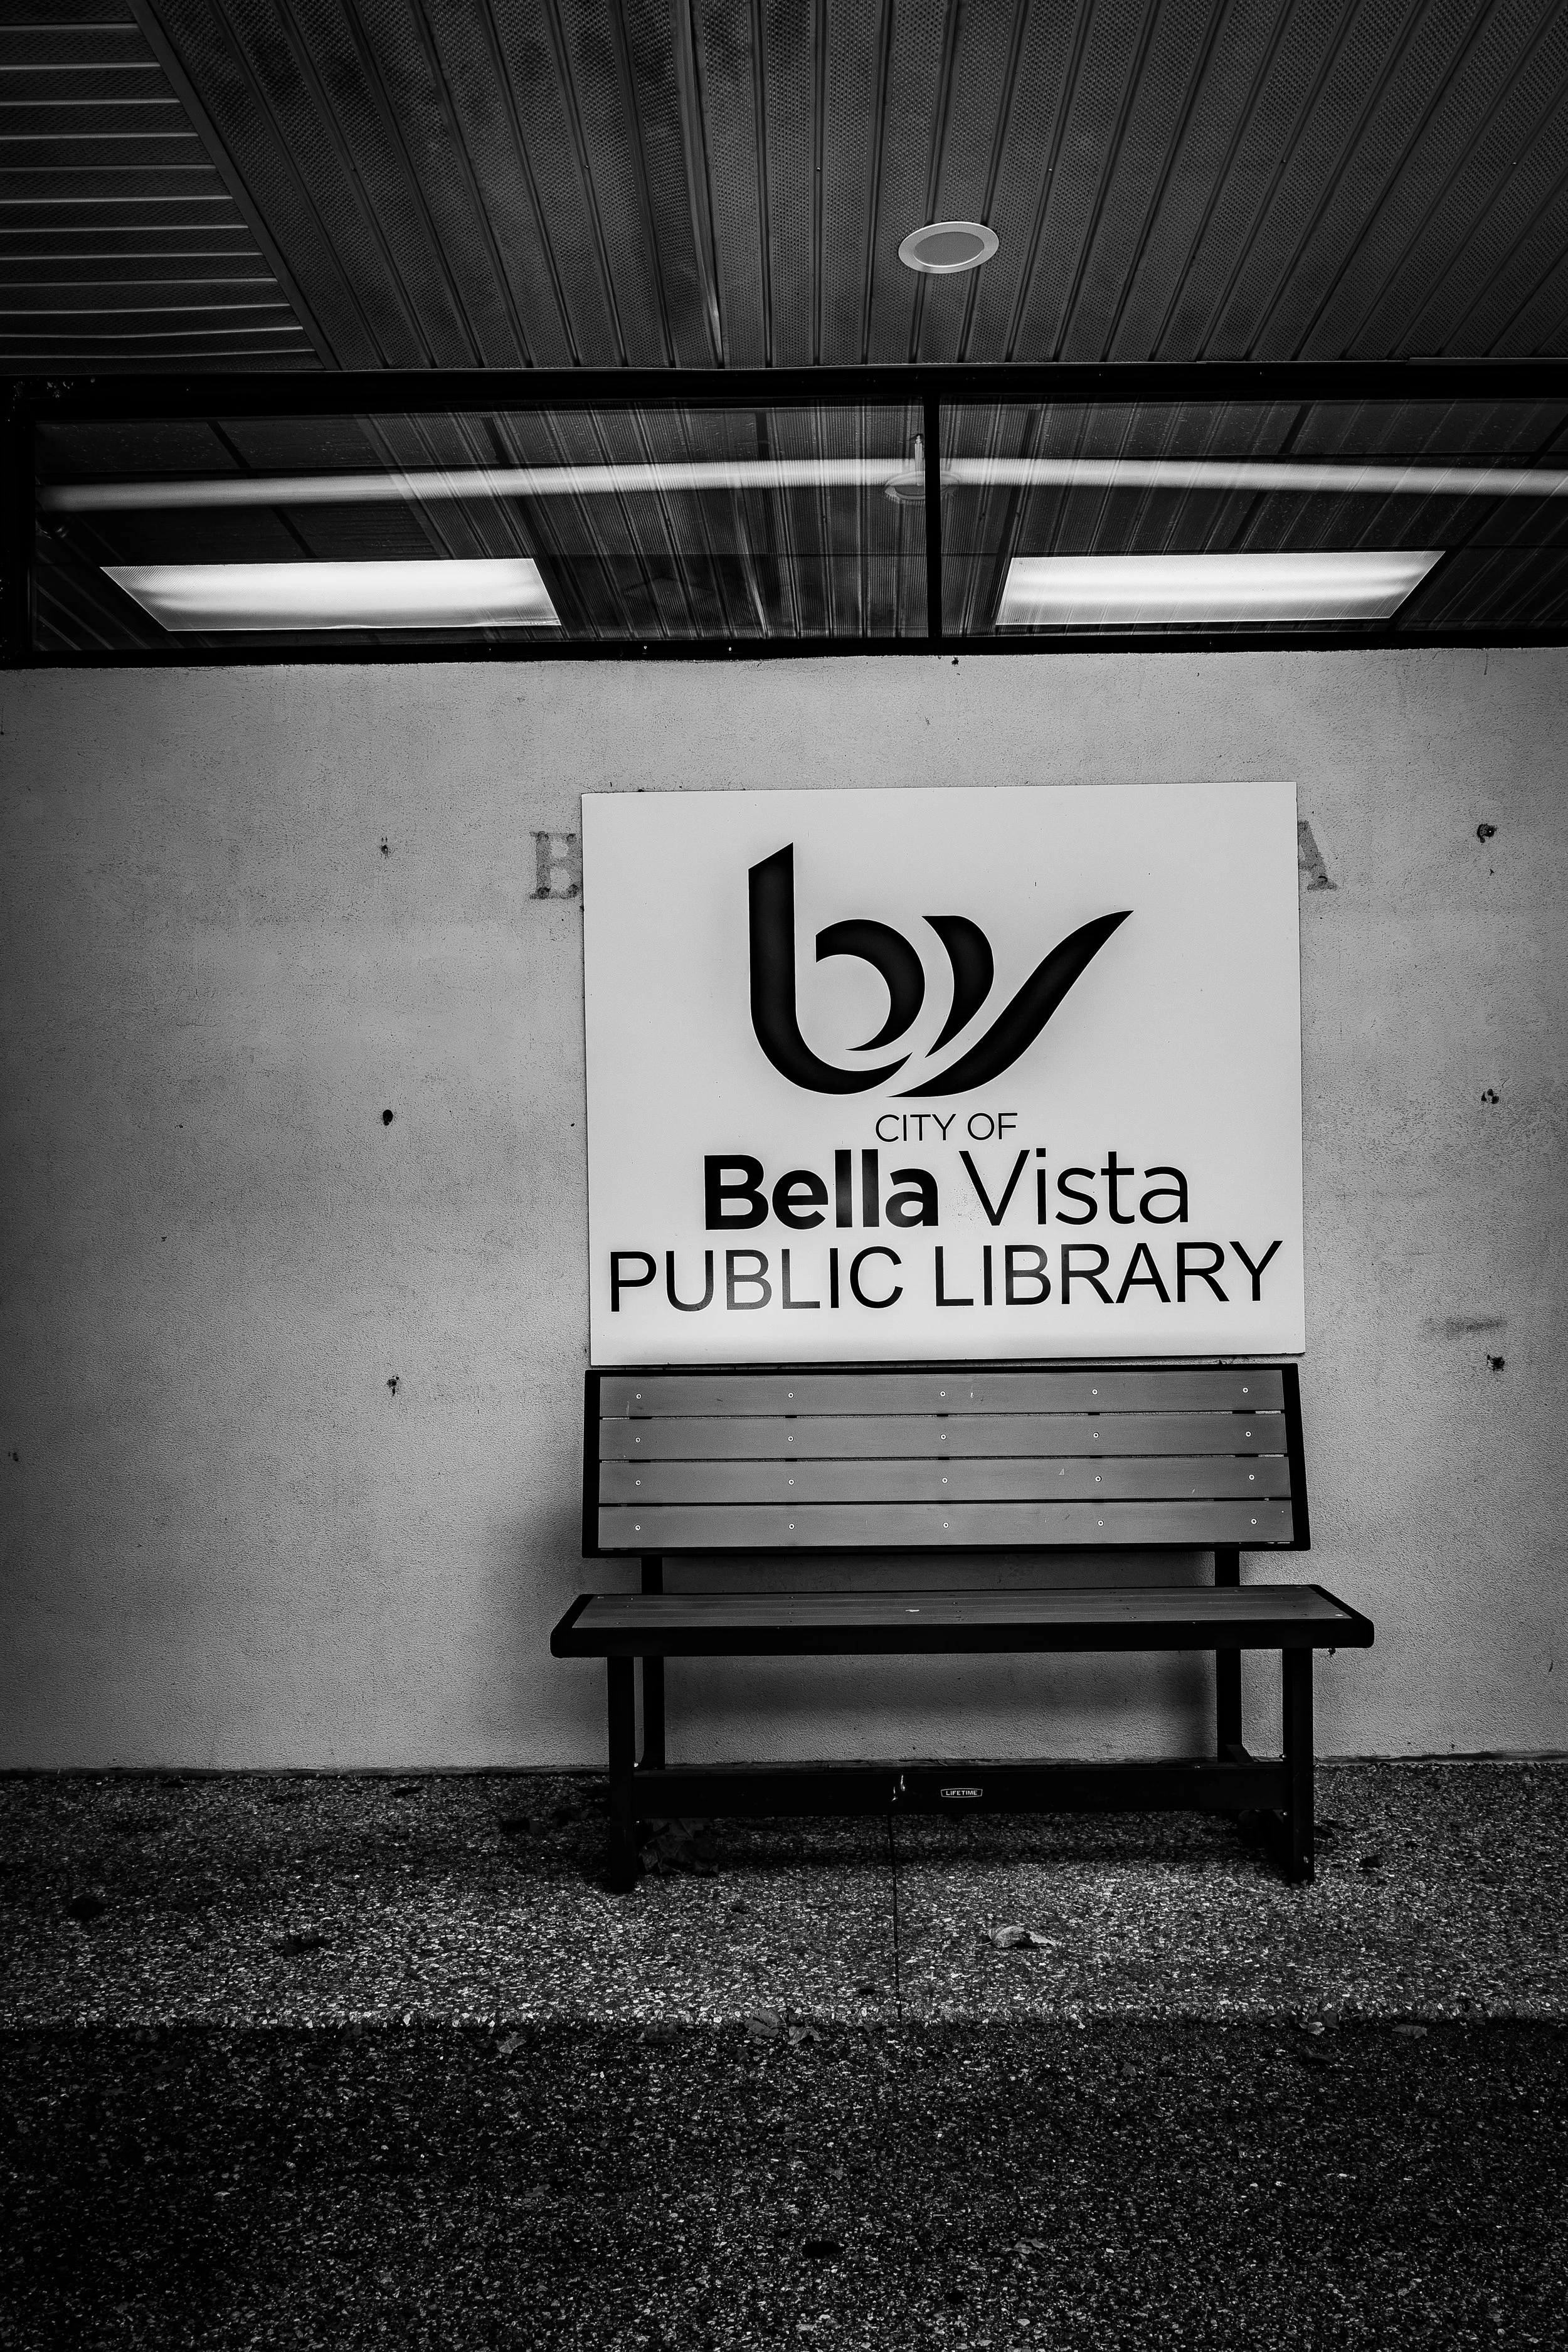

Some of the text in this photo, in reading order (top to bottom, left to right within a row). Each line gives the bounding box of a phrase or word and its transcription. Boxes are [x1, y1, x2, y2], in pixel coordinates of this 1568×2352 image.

[876, 1112, 1018, 1142] CITY OF
[704, 1148, 1189, 1230] Bella Vista
[610, 1241, 1283, 1312] PUBLIC LIBRARY
